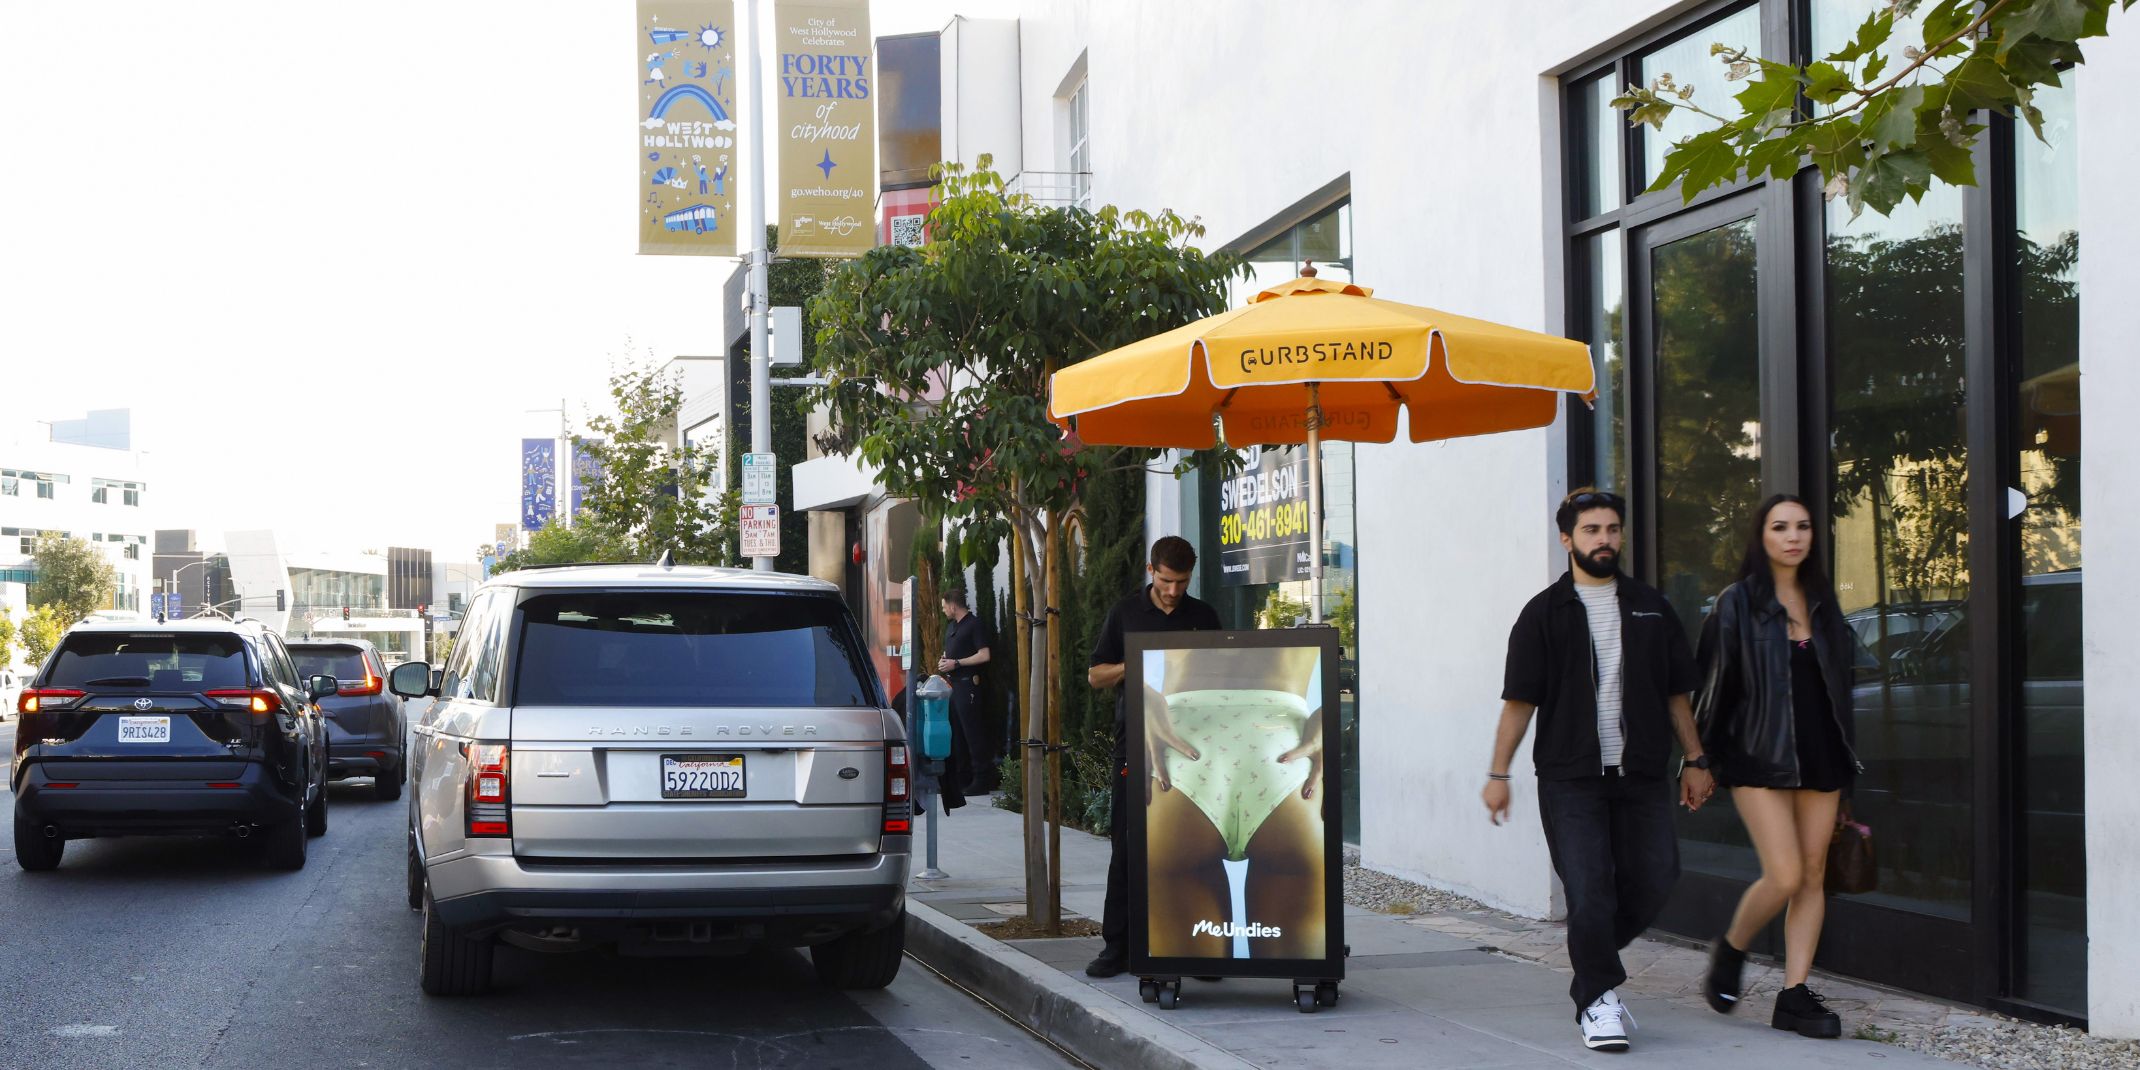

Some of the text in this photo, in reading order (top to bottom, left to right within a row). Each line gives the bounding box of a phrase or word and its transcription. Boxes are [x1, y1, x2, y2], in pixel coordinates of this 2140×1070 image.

[808, 18, 836, 28] City of
[790, 26, 857, 37] West Hollywood
[802, 37, 845, 46] Celebrates
[782, 53, 868, 76] FORTY
[782, 77, 869, 99] YEARS
[815, 101, 838, 123] of
[667, 121, 712, 135] WEST
[791, 122, 861, 143] cityhood
[644, 135, 733, 149] HOLLYWOOD
[791, 186, 864, 199] go.weho.org/40
[1240, 341, 1393, 374] CURBSTAND
[744, 455, 751, 465] 2
[1221, 464, 1298, 511] SWEDELSON
[742, 507, 753, 519] NO
[743, 520, 776, 529] PARKING
[1221, 500, 1308, 545] 310-461-8941
[745, 530, 775, 538] 5AM 7AM
[122, 726, 167, 739] 9RIS428
[588, 725, 817, 736] RANGE ROVER
[678, 761, 725, 771] California
[1192, 919, 1282, 938] MeUndies
